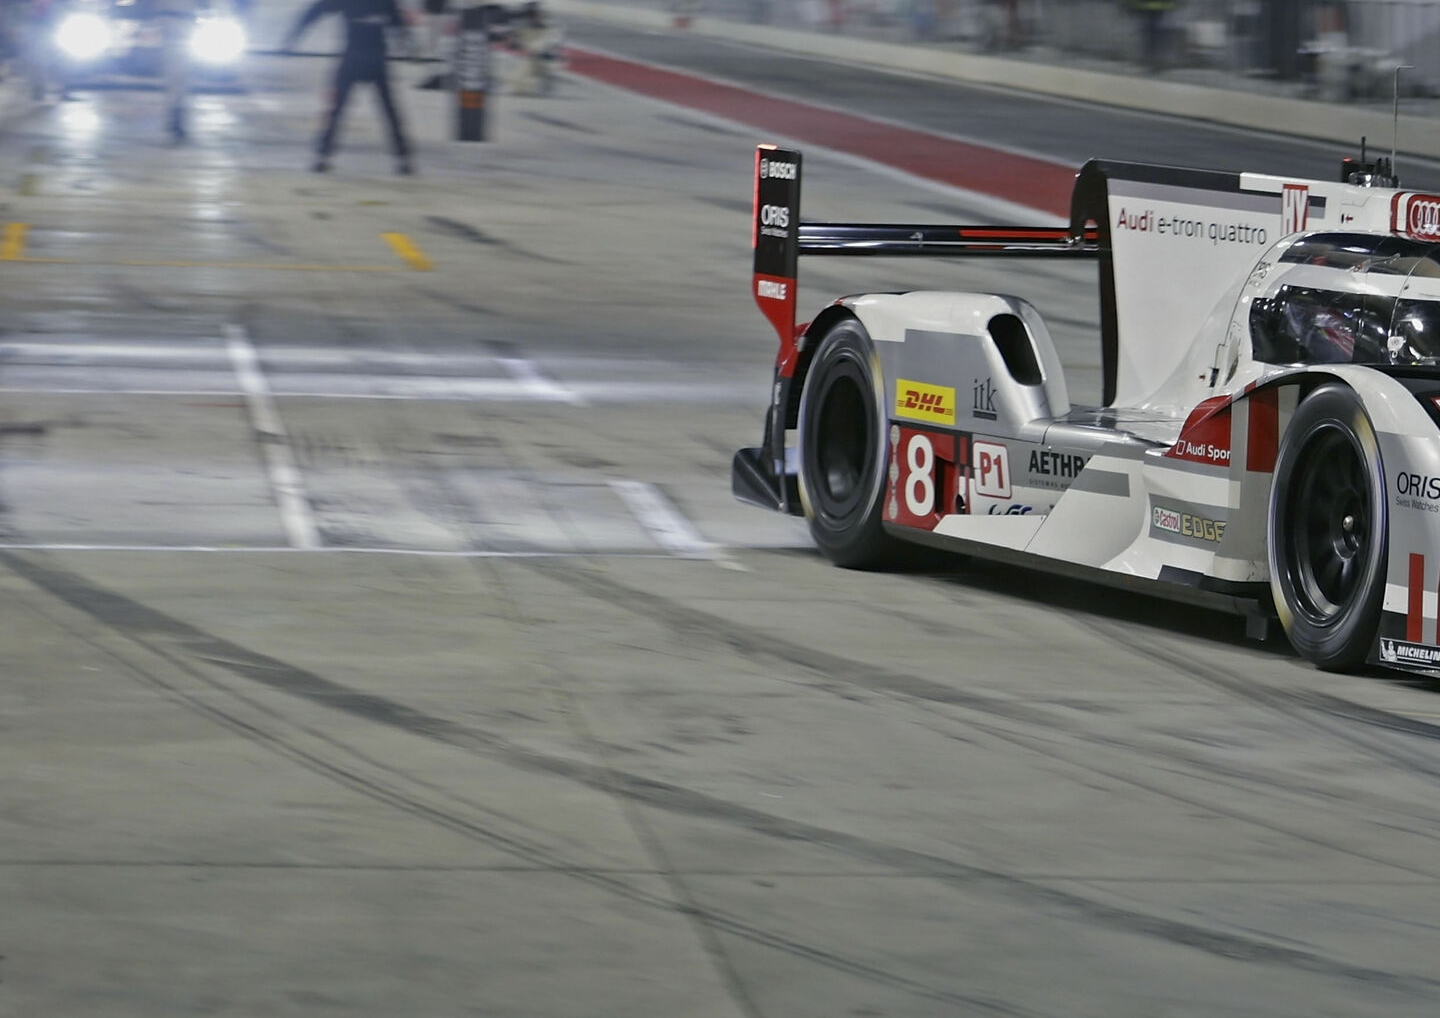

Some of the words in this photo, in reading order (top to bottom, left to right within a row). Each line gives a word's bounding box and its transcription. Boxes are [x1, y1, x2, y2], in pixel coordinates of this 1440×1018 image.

[768, 161, 797, 180] BOSCH
[761, 204, 789, 228] ORIS
[1281, 187, 1309, 237] HY
[1116, 207, 1154, 233] Audi
[1157, 214, 1204, 239] e-tron
[1208, 221, 1268, 246] quattro
[757, 279, 787, 300] MAHLE
[903, 389, 947, 415] DHL
[972, 377, 998, 413] itk
[1028, 449, 1091, 479] AETHR
[1186, 441, 1206, 457] Audi
[1207, 444, 1231, 462] Spor
[903, 433, 936, 517] 8
[979, 450, 1004, 490] P1
[1159, 510, 1180, 530] Castrol
